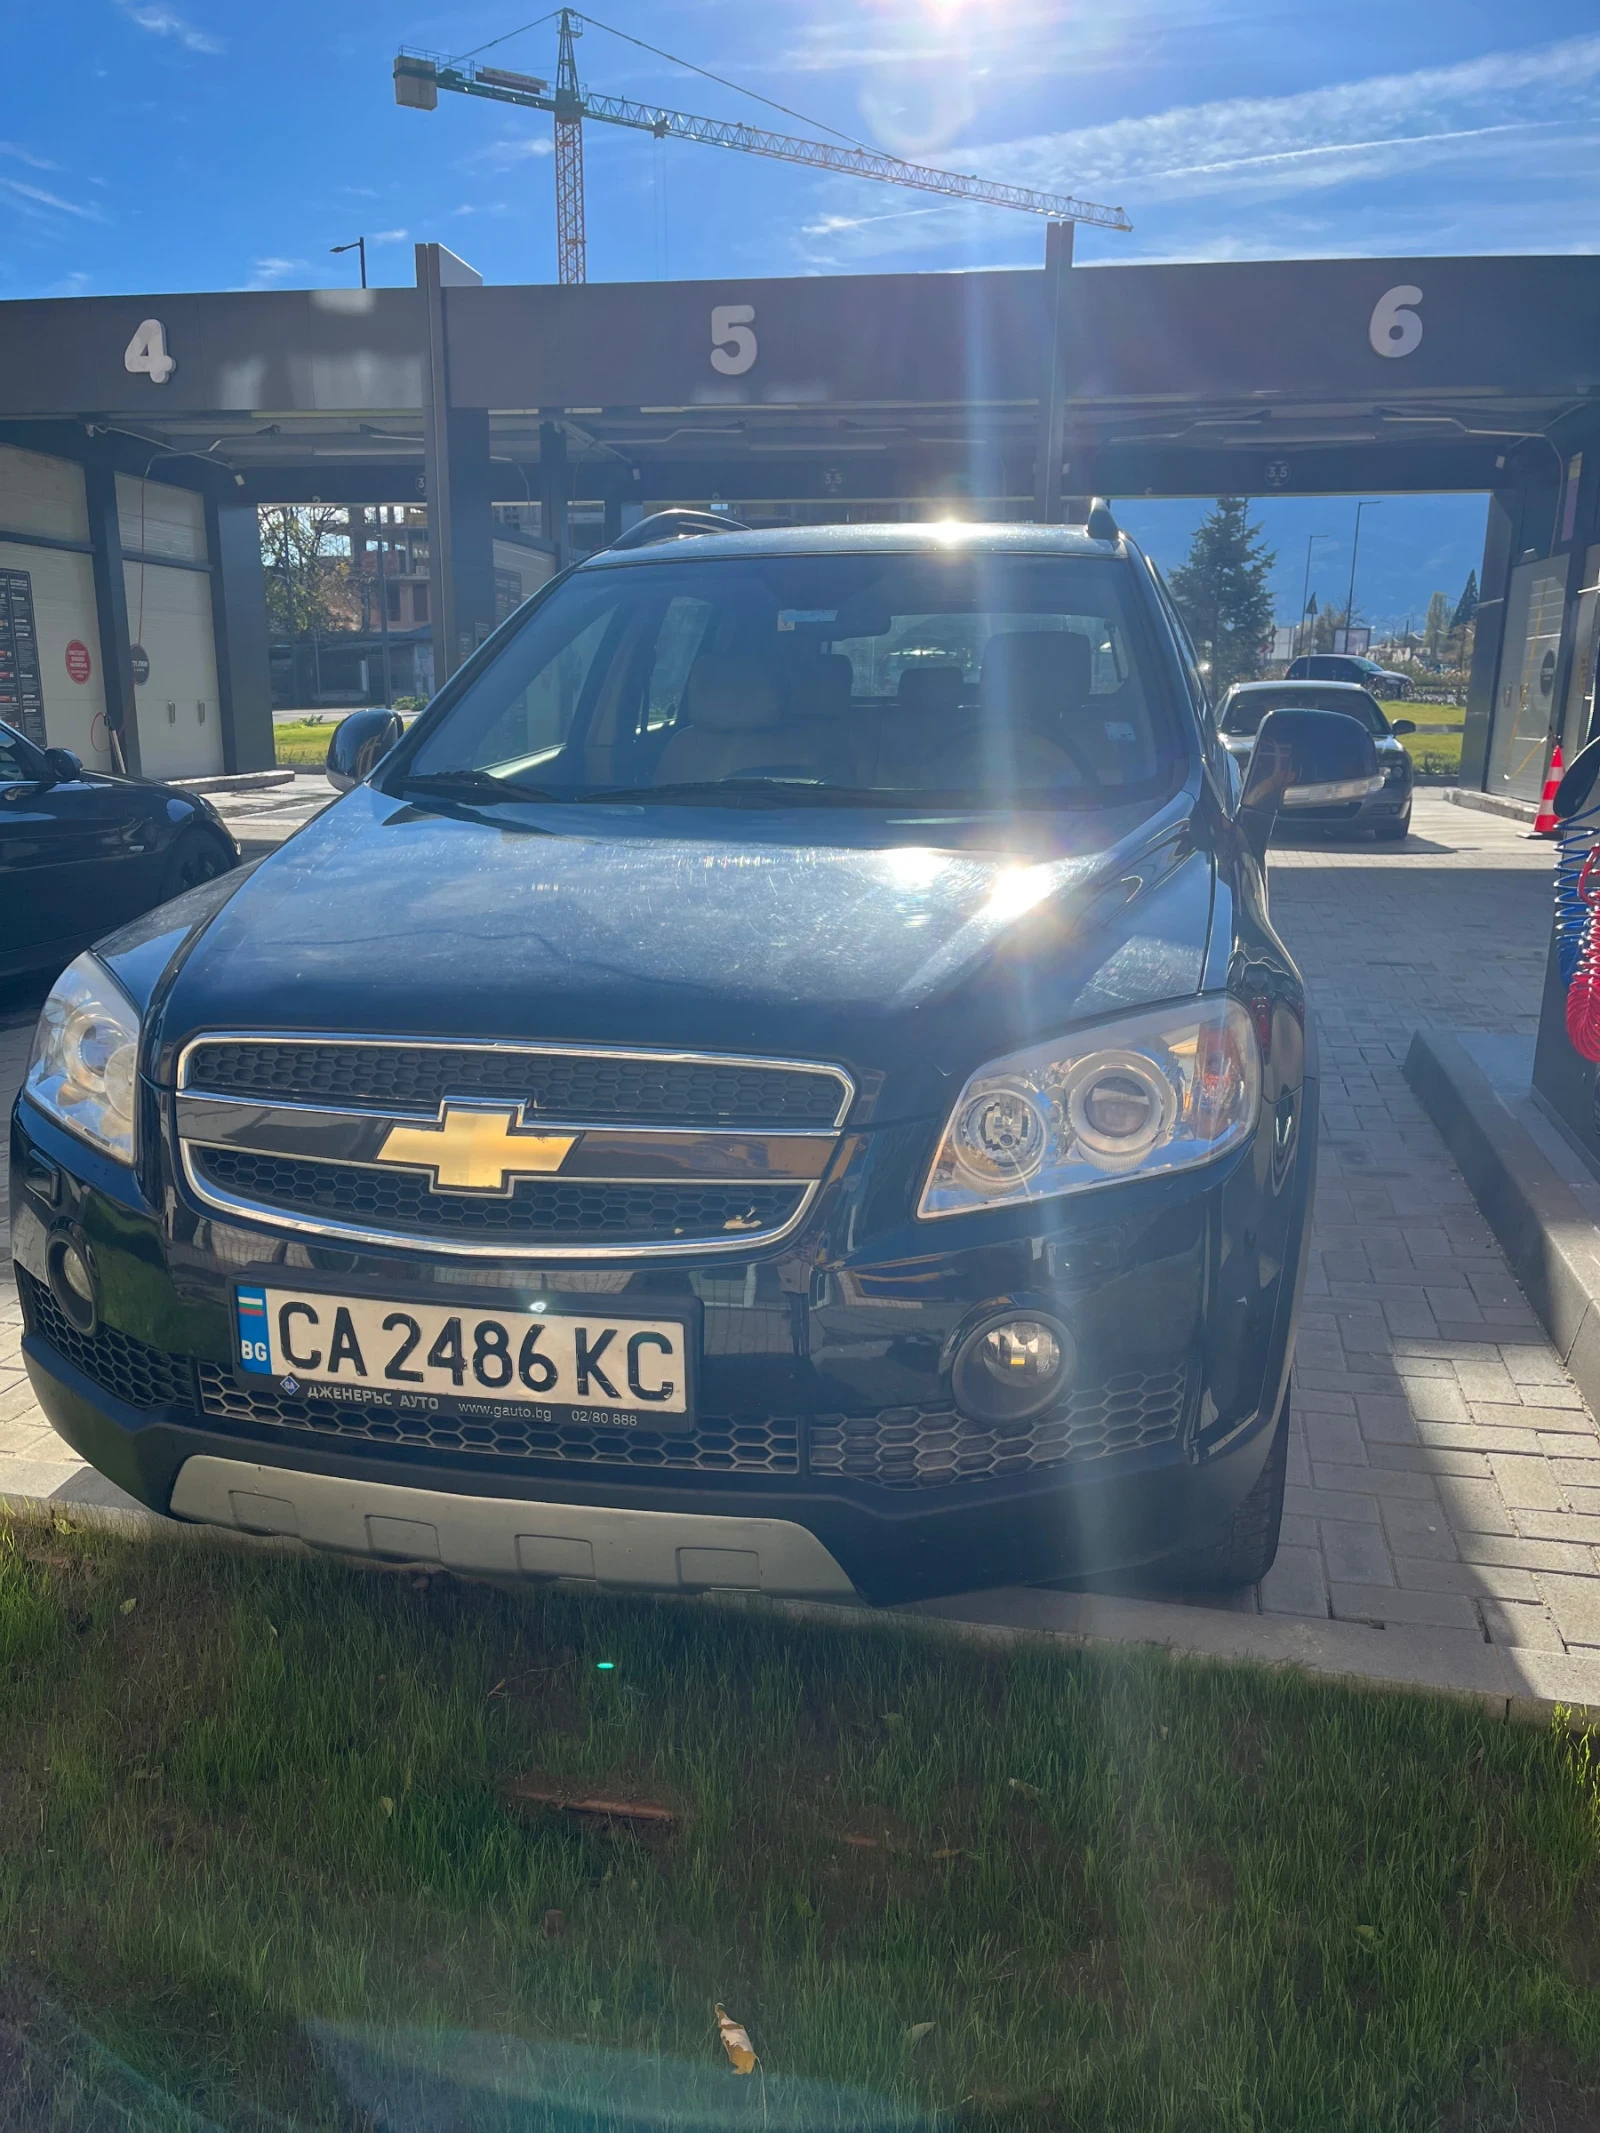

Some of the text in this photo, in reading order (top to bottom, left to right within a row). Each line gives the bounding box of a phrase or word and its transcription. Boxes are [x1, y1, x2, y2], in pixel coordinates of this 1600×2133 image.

[125, 319, 176, 383] 4
[711, 304, 757, 375] 5
[1370, 285, 1423, 358] 6
[241, 1340, 267, 1361] BG
[278, 1301, 674, 1401] CA 2486 KC
[400, 1395, 439, 1411] АУТО
[458, 1403, 552, 1421] www.gauto.bg
[571, 1409, 609, 1424] 02/80
[612, 1413, 638, 1427] 888
